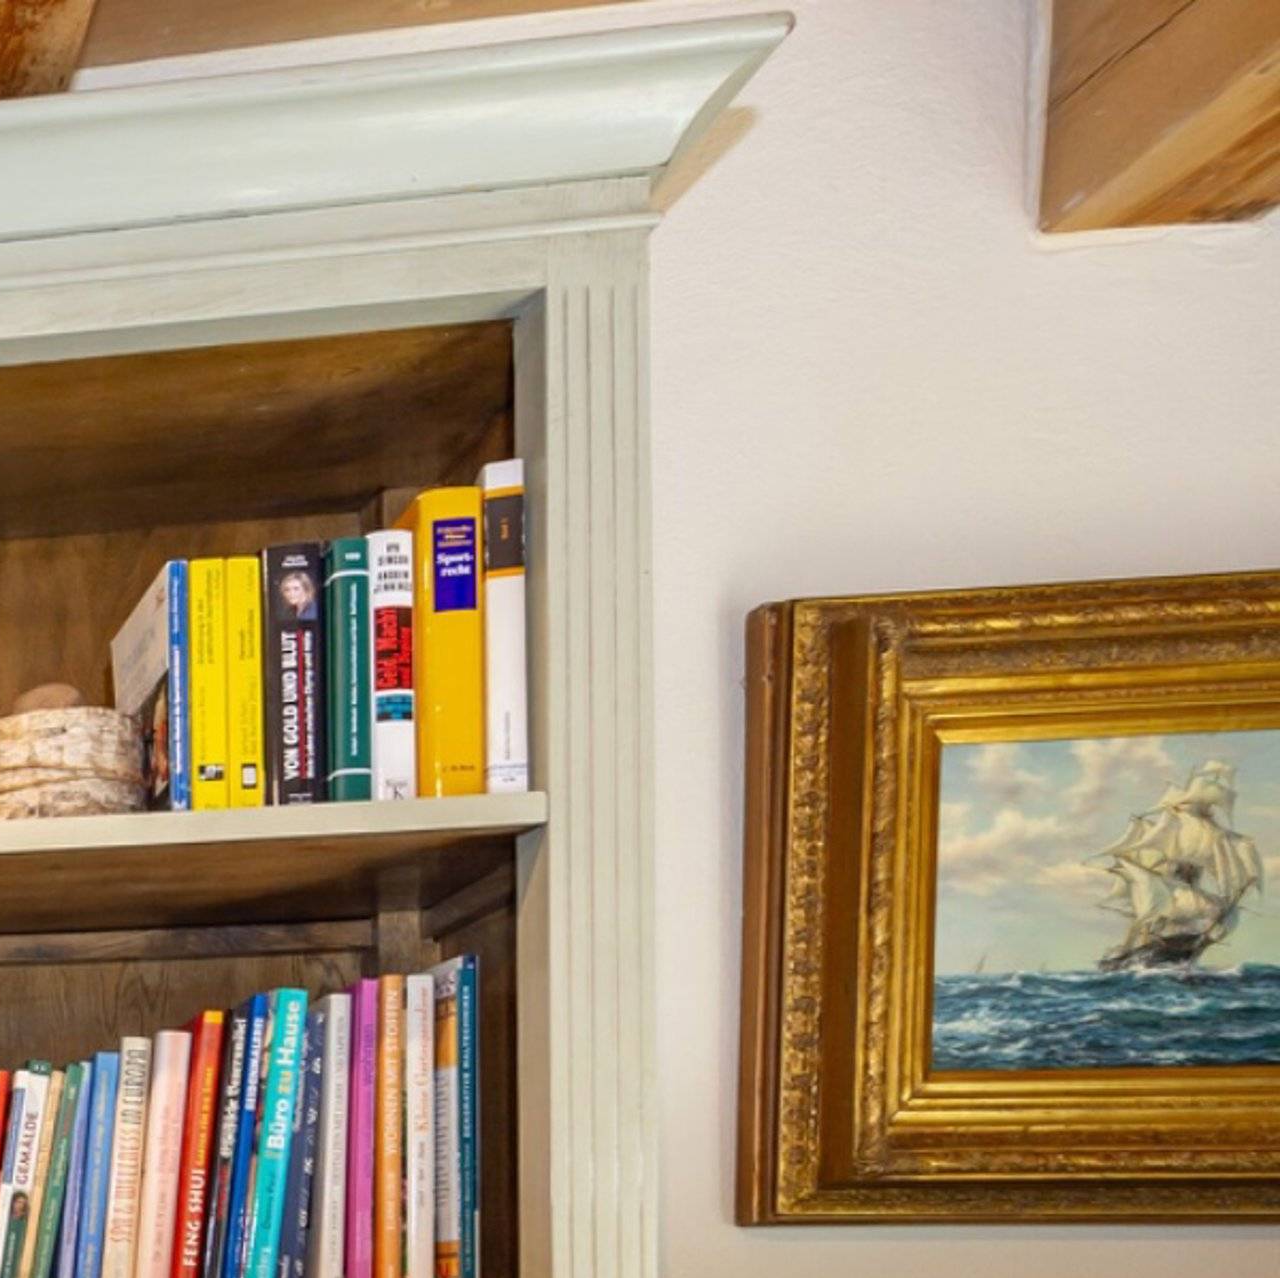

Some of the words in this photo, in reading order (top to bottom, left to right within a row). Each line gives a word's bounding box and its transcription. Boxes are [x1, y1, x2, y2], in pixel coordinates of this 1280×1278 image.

[281, 631, 297, 668] BLUT
[281, 671, 297, 702] UND
[282, 704, 298, 745] GOLD
[283, 749, 300, 779] VON
[276, 1000, 302, 1066] Hause
[266, 1098, 290, 1150] Büro
[187, 1168, 207, 1213] SHUI
[183, 1220, 202, 1267] FENG
